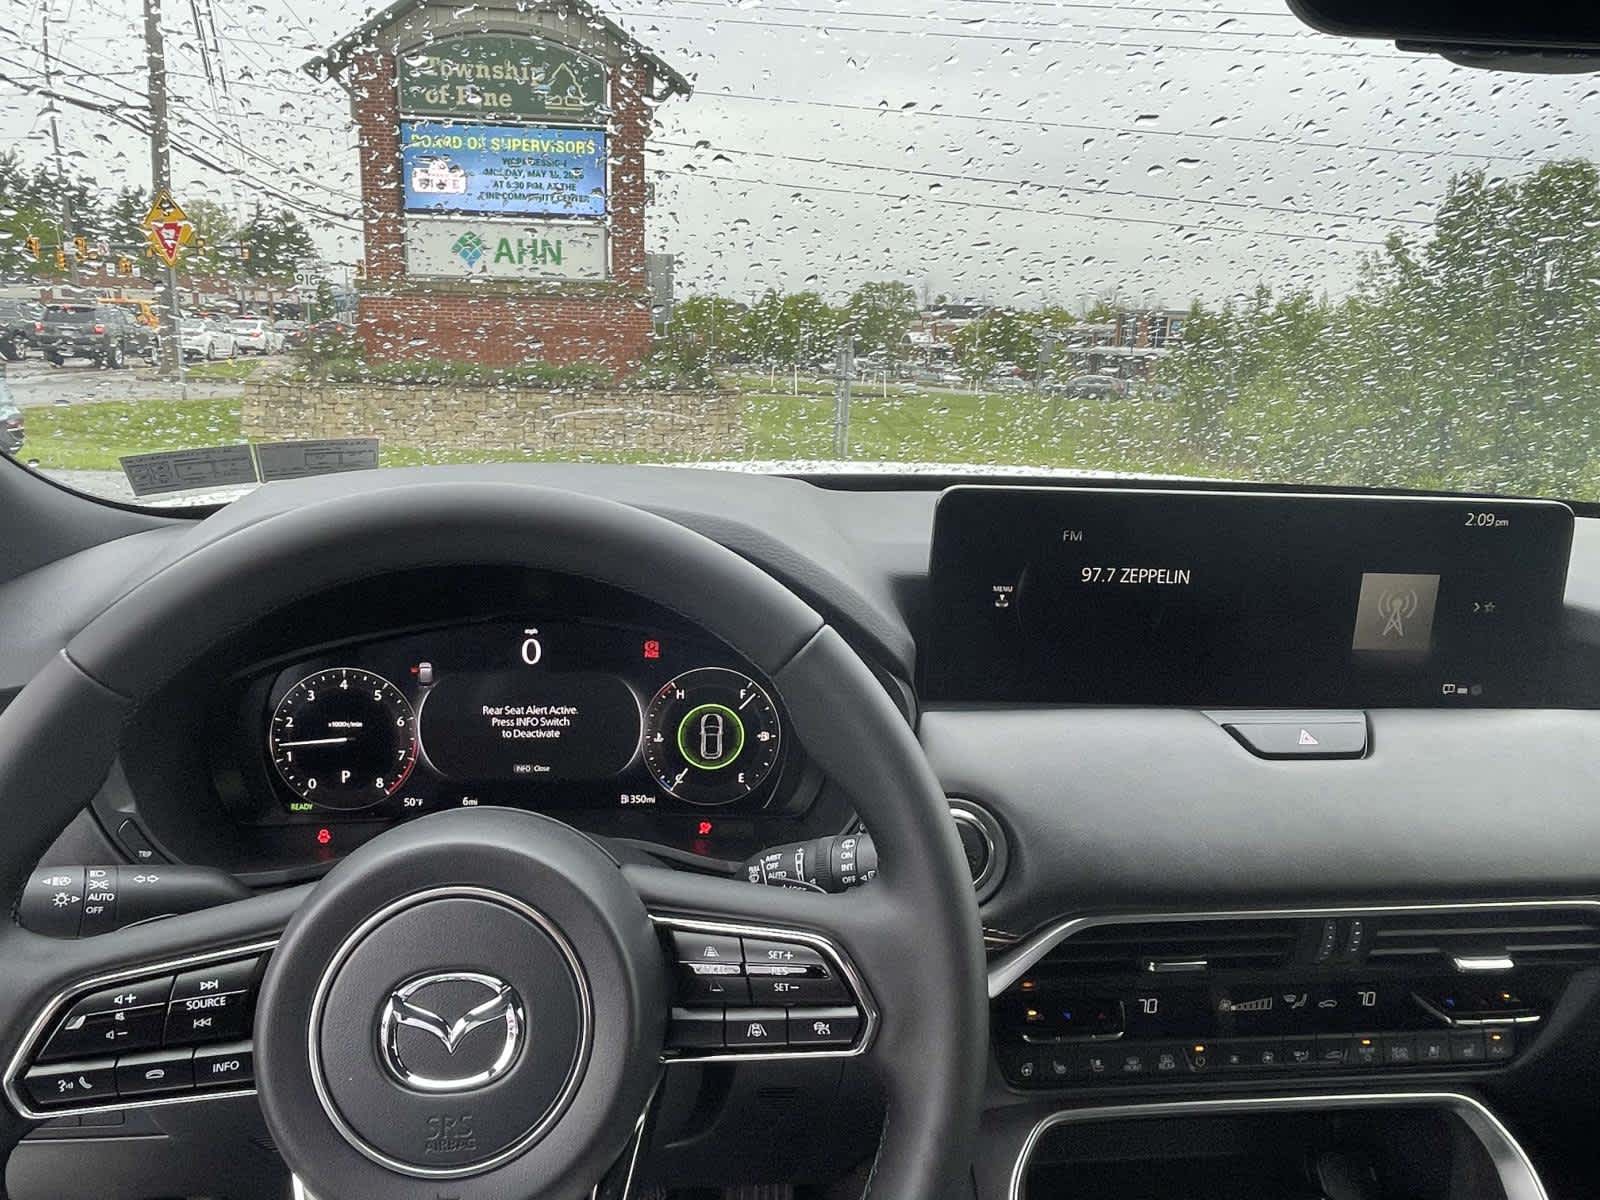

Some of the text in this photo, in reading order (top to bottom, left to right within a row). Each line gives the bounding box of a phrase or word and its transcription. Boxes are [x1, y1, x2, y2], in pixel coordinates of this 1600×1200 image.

[425, 84, 513, 107] of Pne
[494, 237, 563, 266] AHN
[1063, 530, 1083, 542] FM
[1081, 567, 1191, 584] 97.7 ZEPPELIN
[992, 585, 1013, 593] MENU
[521, 638, 542, 665] 0
[339, 680, 348, 690] 4
[306, 690, 316, 701] 3
[374, 690, 382, 701] 5
[676, 690, 685, 700] H
[739, 689, 747, 700] F
[482, 705, 504, 715] Rear
[504, 705, 525, 715] Seat
[525, 704, 548, 715] Alert
[285, 717, 294, 728] 2
[396, 717, 405, 727] 6
[491, 716, 571, 727] Press INFO Switch
[502, 729, 561, 738] to Deactivate
[286, 751, 293, 762] 1
[397, 750, 406, 761] 7
[533, 764, 550, 772] Close
[341, 770, 351, 783] P
[738, 772, 745, 783] E
[308, 778, 317, 790] 0
[375, 777, 384, 788] 8
[629, 795, 656, 804] 350mi
[290, 803, 313, 811] READY
[840, 851, 853, 860] ON
[766, 862, 779, 871] OFF
[841, 863, 853, 872] INT
[768, 870, 787, 880] AUTO
[842, 875, 856, 884] OFF
[88, 892, 115, 902] AUTO
[85, 906, 104, 915] OFF
[186, 996, 226, 1011] SOURCE
[1357, 991, 1376, 1007] 70
[1138, 998, 1158, 1014] 70
[212, 1060, 240, 1074] INFO
[425, 1115, 473, 1140] SRS
